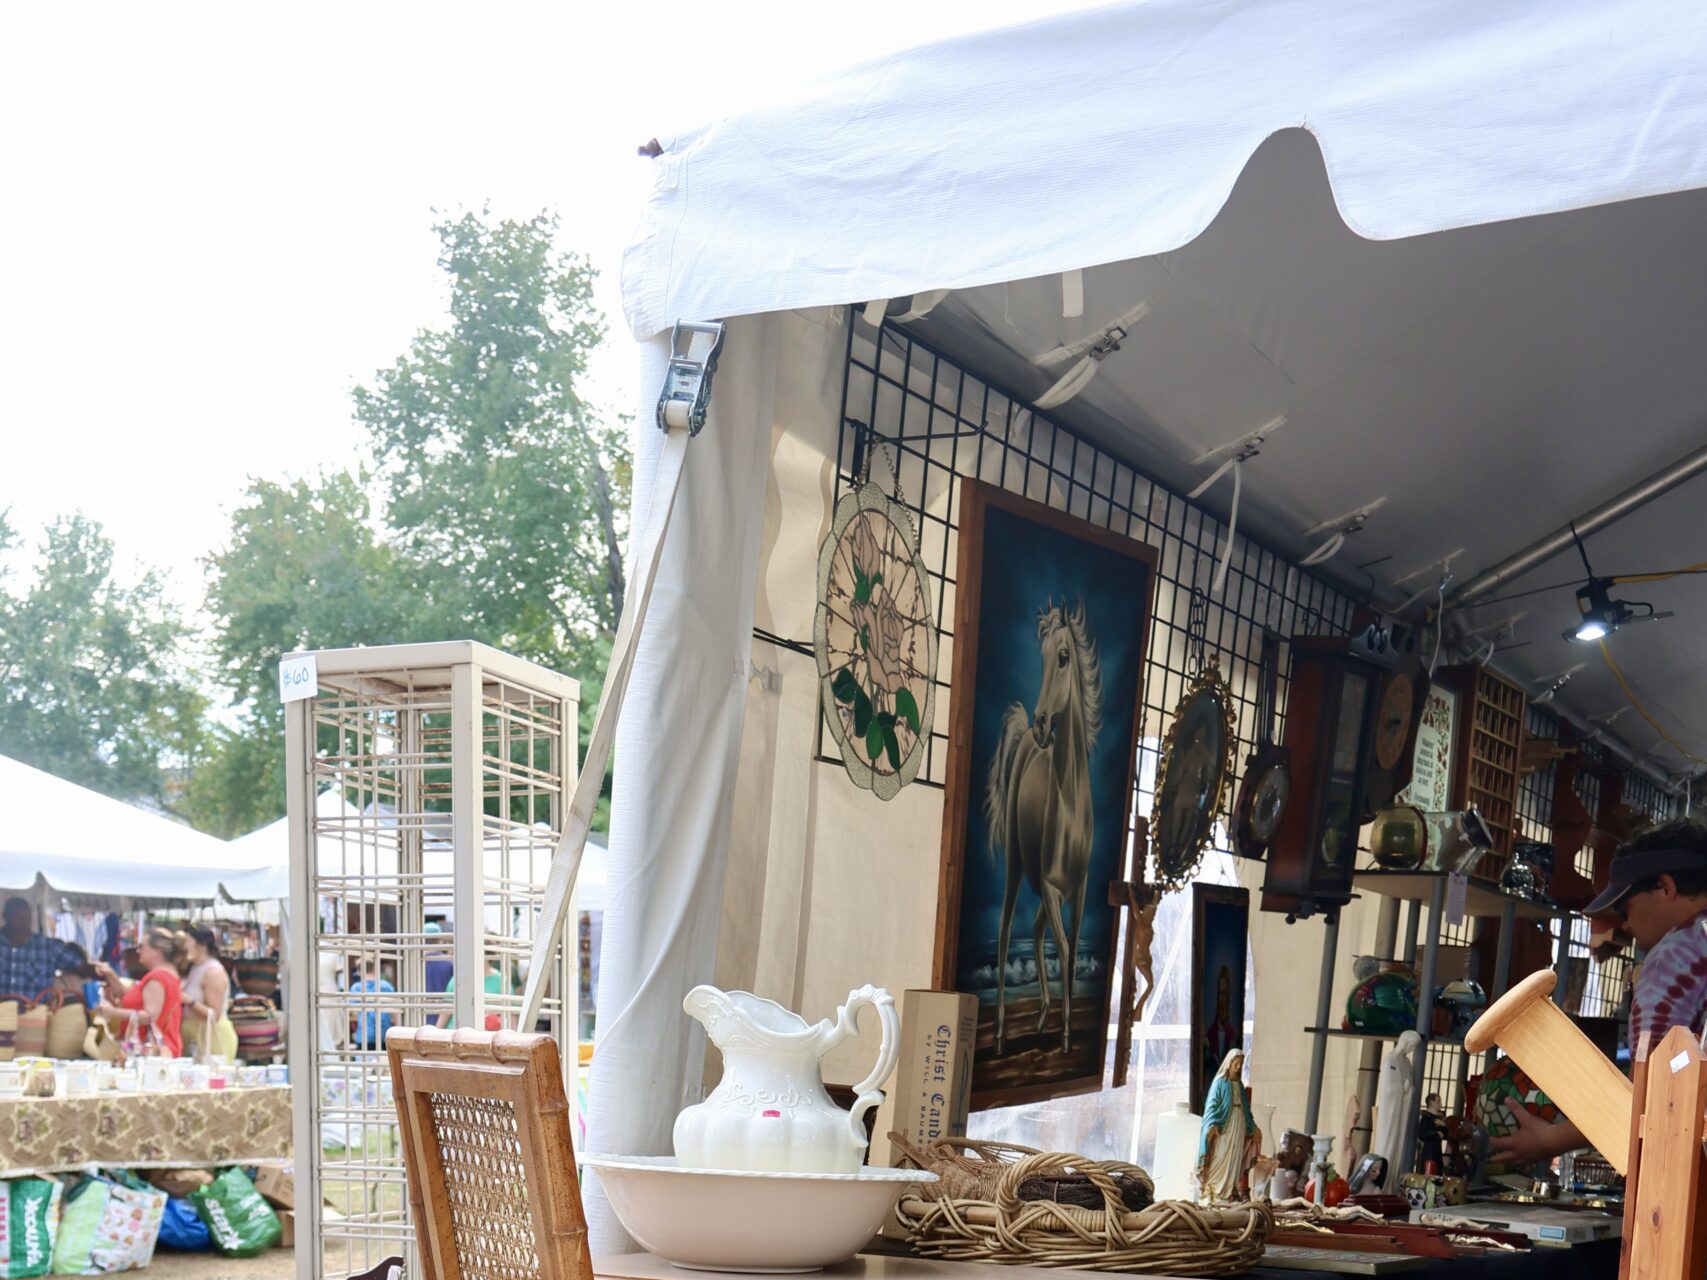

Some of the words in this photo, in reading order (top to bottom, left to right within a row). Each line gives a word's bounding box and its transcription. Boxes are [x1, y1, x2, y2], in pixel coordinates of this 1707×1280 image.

[923, 1056, 931, 1084] WILL
[933, 1025, 951, 1083] Christ
[928, 1093, 945, 1144] Cand
